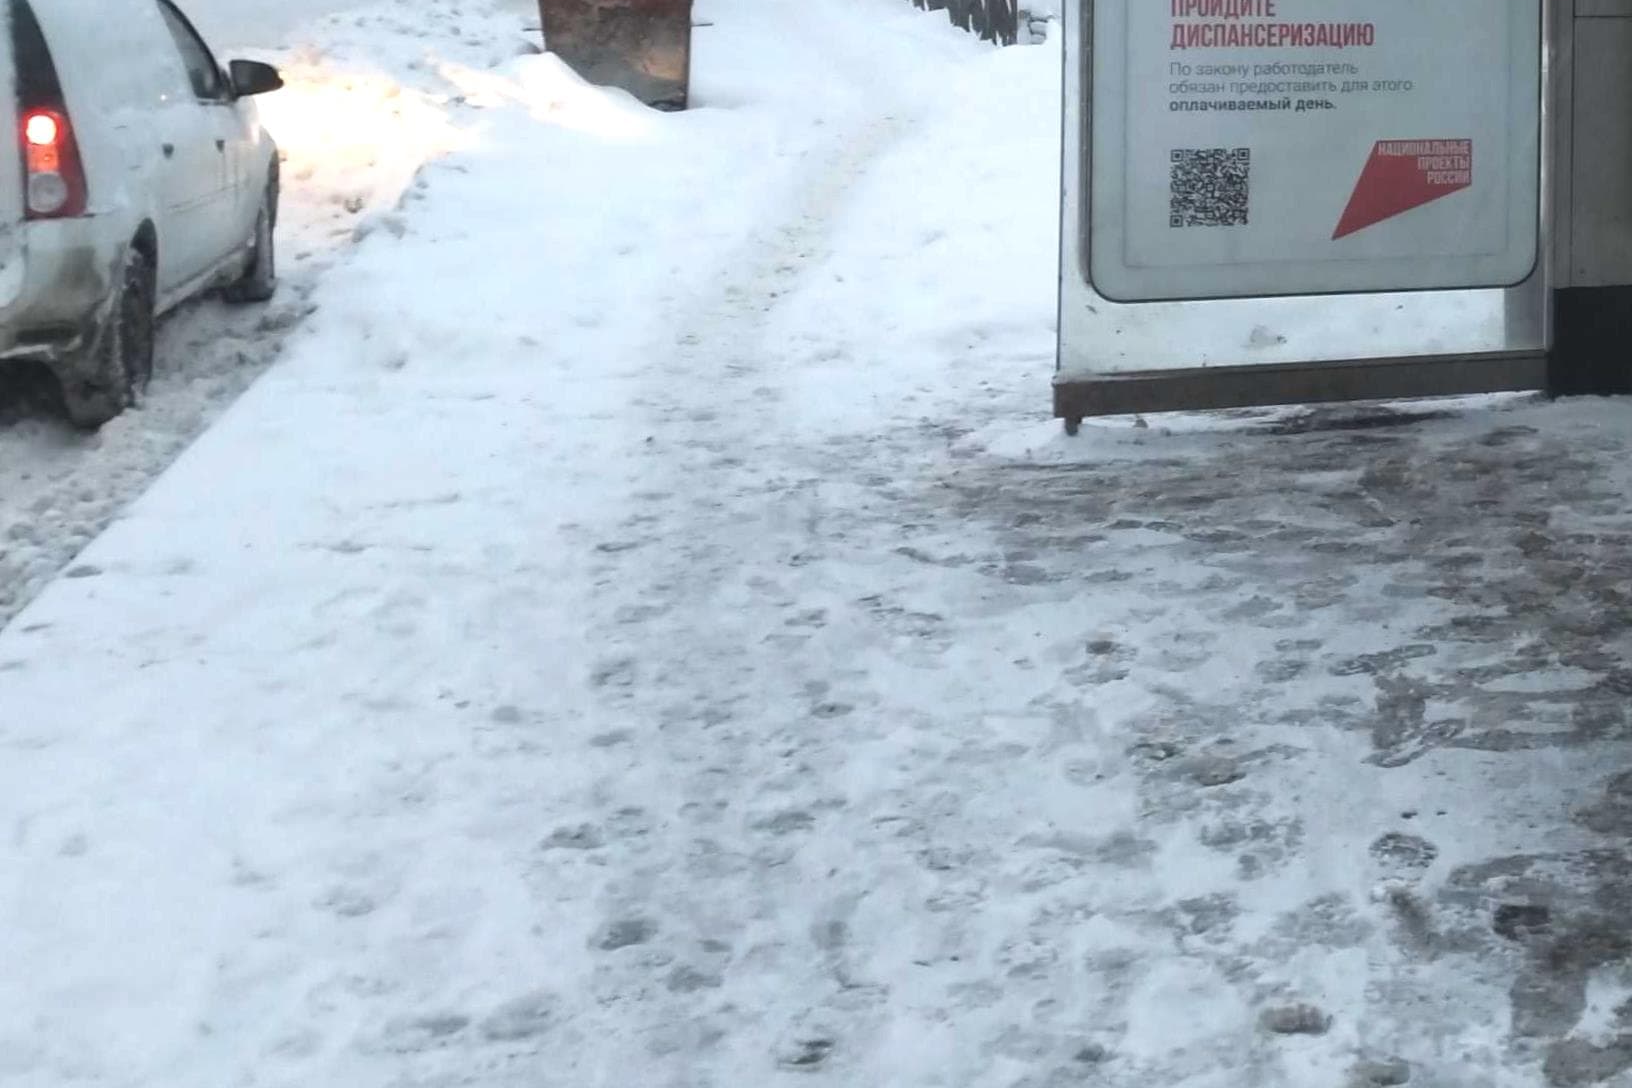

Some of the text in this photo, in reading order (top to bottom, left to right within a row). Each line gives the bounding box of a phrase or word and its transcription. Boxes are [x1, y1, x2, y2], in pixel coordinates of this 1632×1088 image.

[1170, 23, 1375, 50] ДИСПАНСЕРИЗАЦИЮ
[1169, 62, 1359, 78] По закону работодатель
[1169, 79, 1413, 95] обязан предоставить для этого
[1169, 96, 1337, 113] оплачиваемый день.
[1378, 141, 1470, 156] НАЦИОНАЛЬНЫЕ
[1417, 156, 1470, 170] ПРОЕКТЫ
[1427, 171, 1470, 185] РОССИИ
